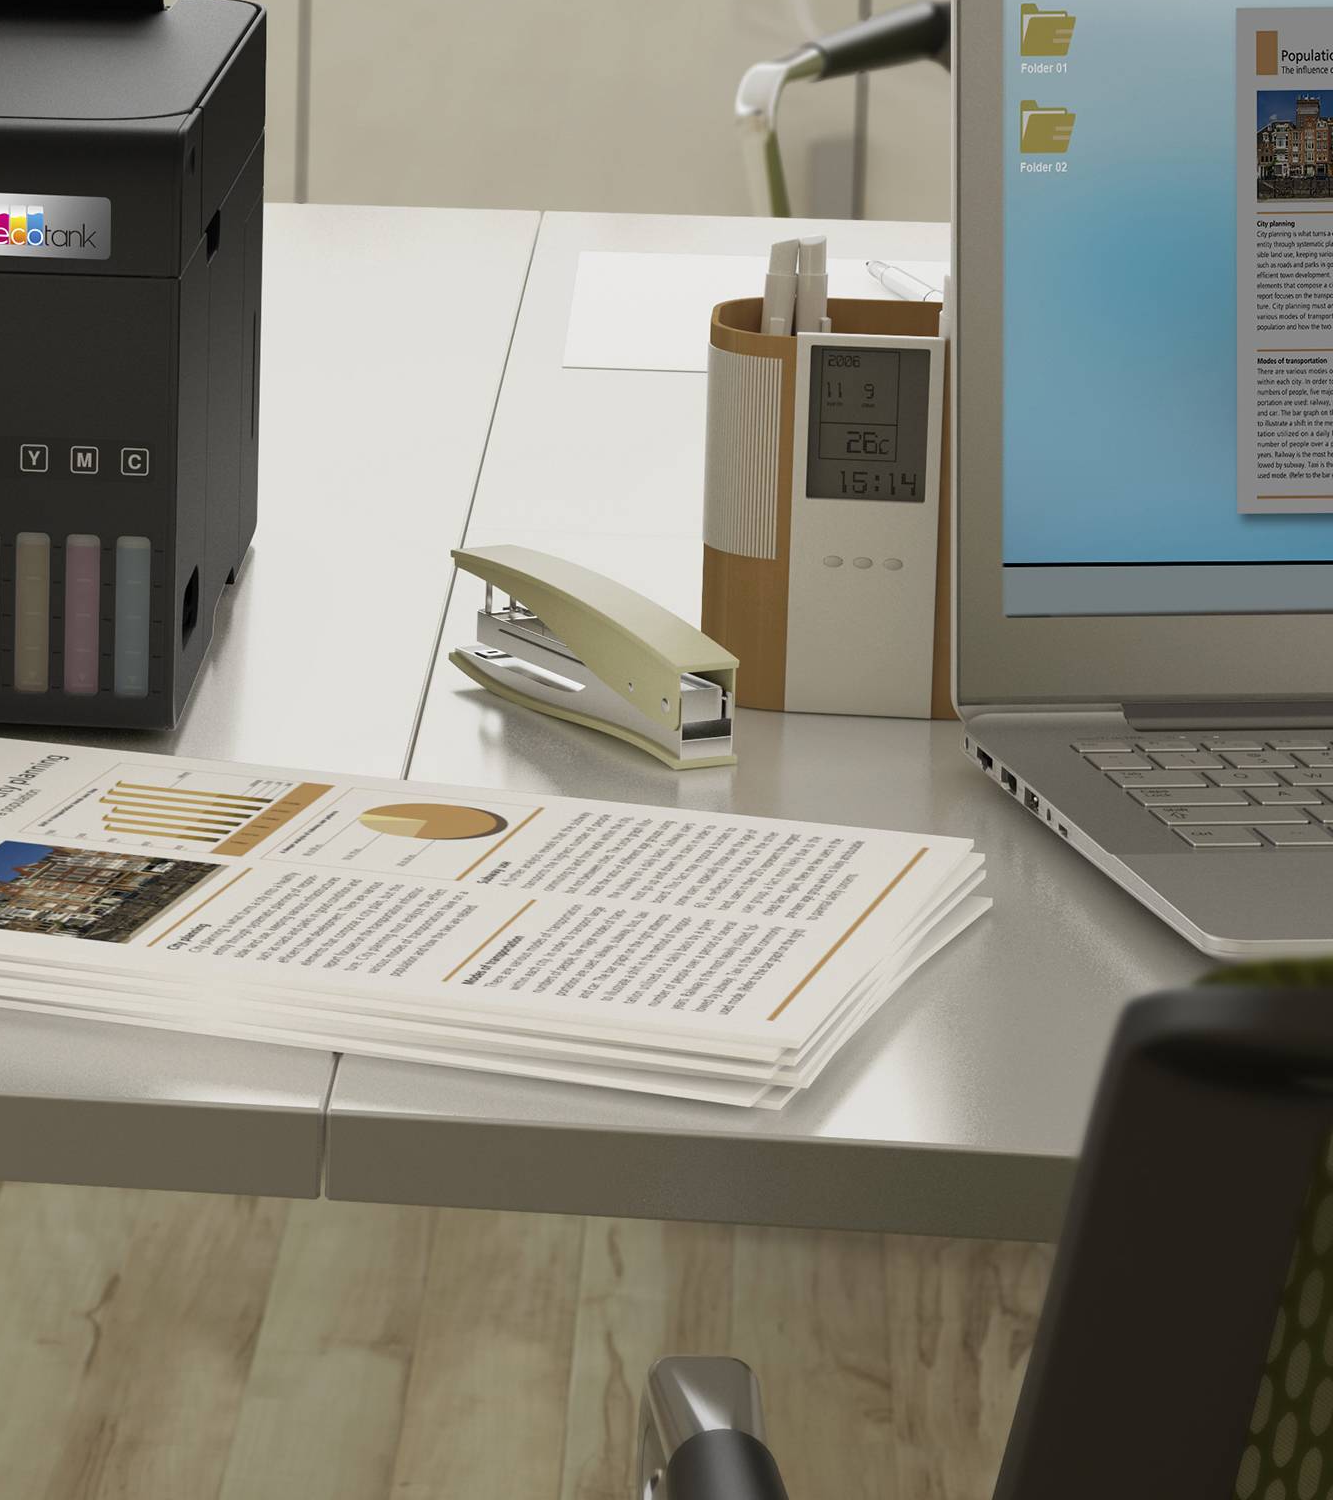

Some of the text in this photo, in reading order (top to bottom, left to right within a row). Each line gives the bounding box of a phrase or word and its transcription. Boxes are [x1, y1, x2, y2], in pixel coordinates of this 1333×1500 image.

[1021, 63, 1068, 74] Folder 01
[1281, 64, 1329, 75] The influence
[1020, 162, 1068, 173] Folder 02
[1257, 220, 1295, 228] City planning
[828, 355, 861, 368] 2006
[1257, 357, 1327, 365] Modes of transportation
[827, 381, 875, 399] 11 9
[28, 450, 41, 465] Y
[77, 452, 92, 468] M
[128, 454, 142, 470] C
[840, 471, 917, 496] 15:14
[8, 754, 70, 785] planning
[167, 923, 212, 951] City planning
[461, 970, 488, 985] Modes
